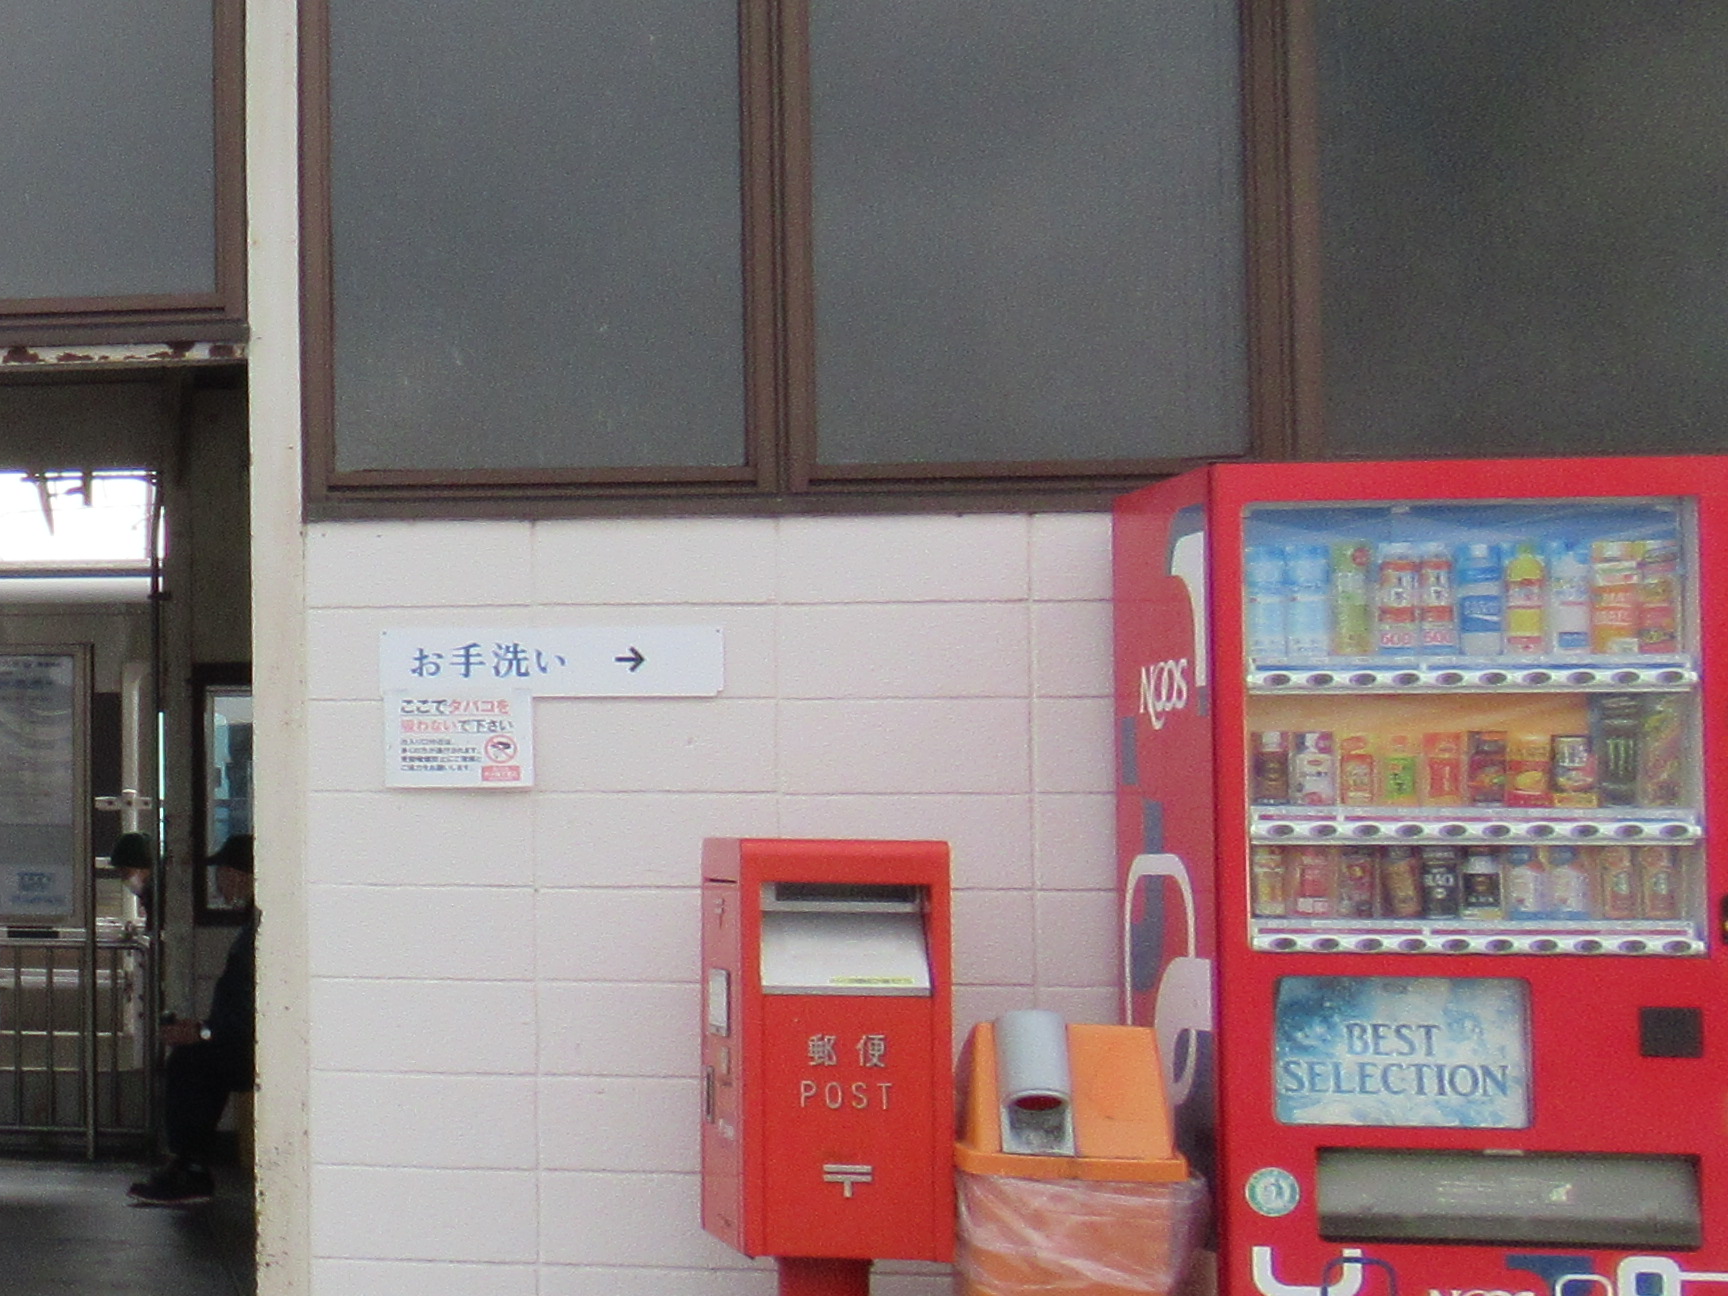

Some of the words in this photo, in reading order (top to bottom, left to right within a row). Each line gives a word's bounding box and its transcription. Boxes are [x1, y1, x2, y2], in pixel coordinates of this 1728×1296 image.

[410, 641, 567, 679] お手洗い
[401, 699, 510, 714] ここでタバコを
[807, 1034, 887, 1068] 郵便
[1344, 1022, 1442, 1056] BEST
[800, 1080, 893, 1110] POST
[1282, 1060, 1509, 1097] SELECTION
